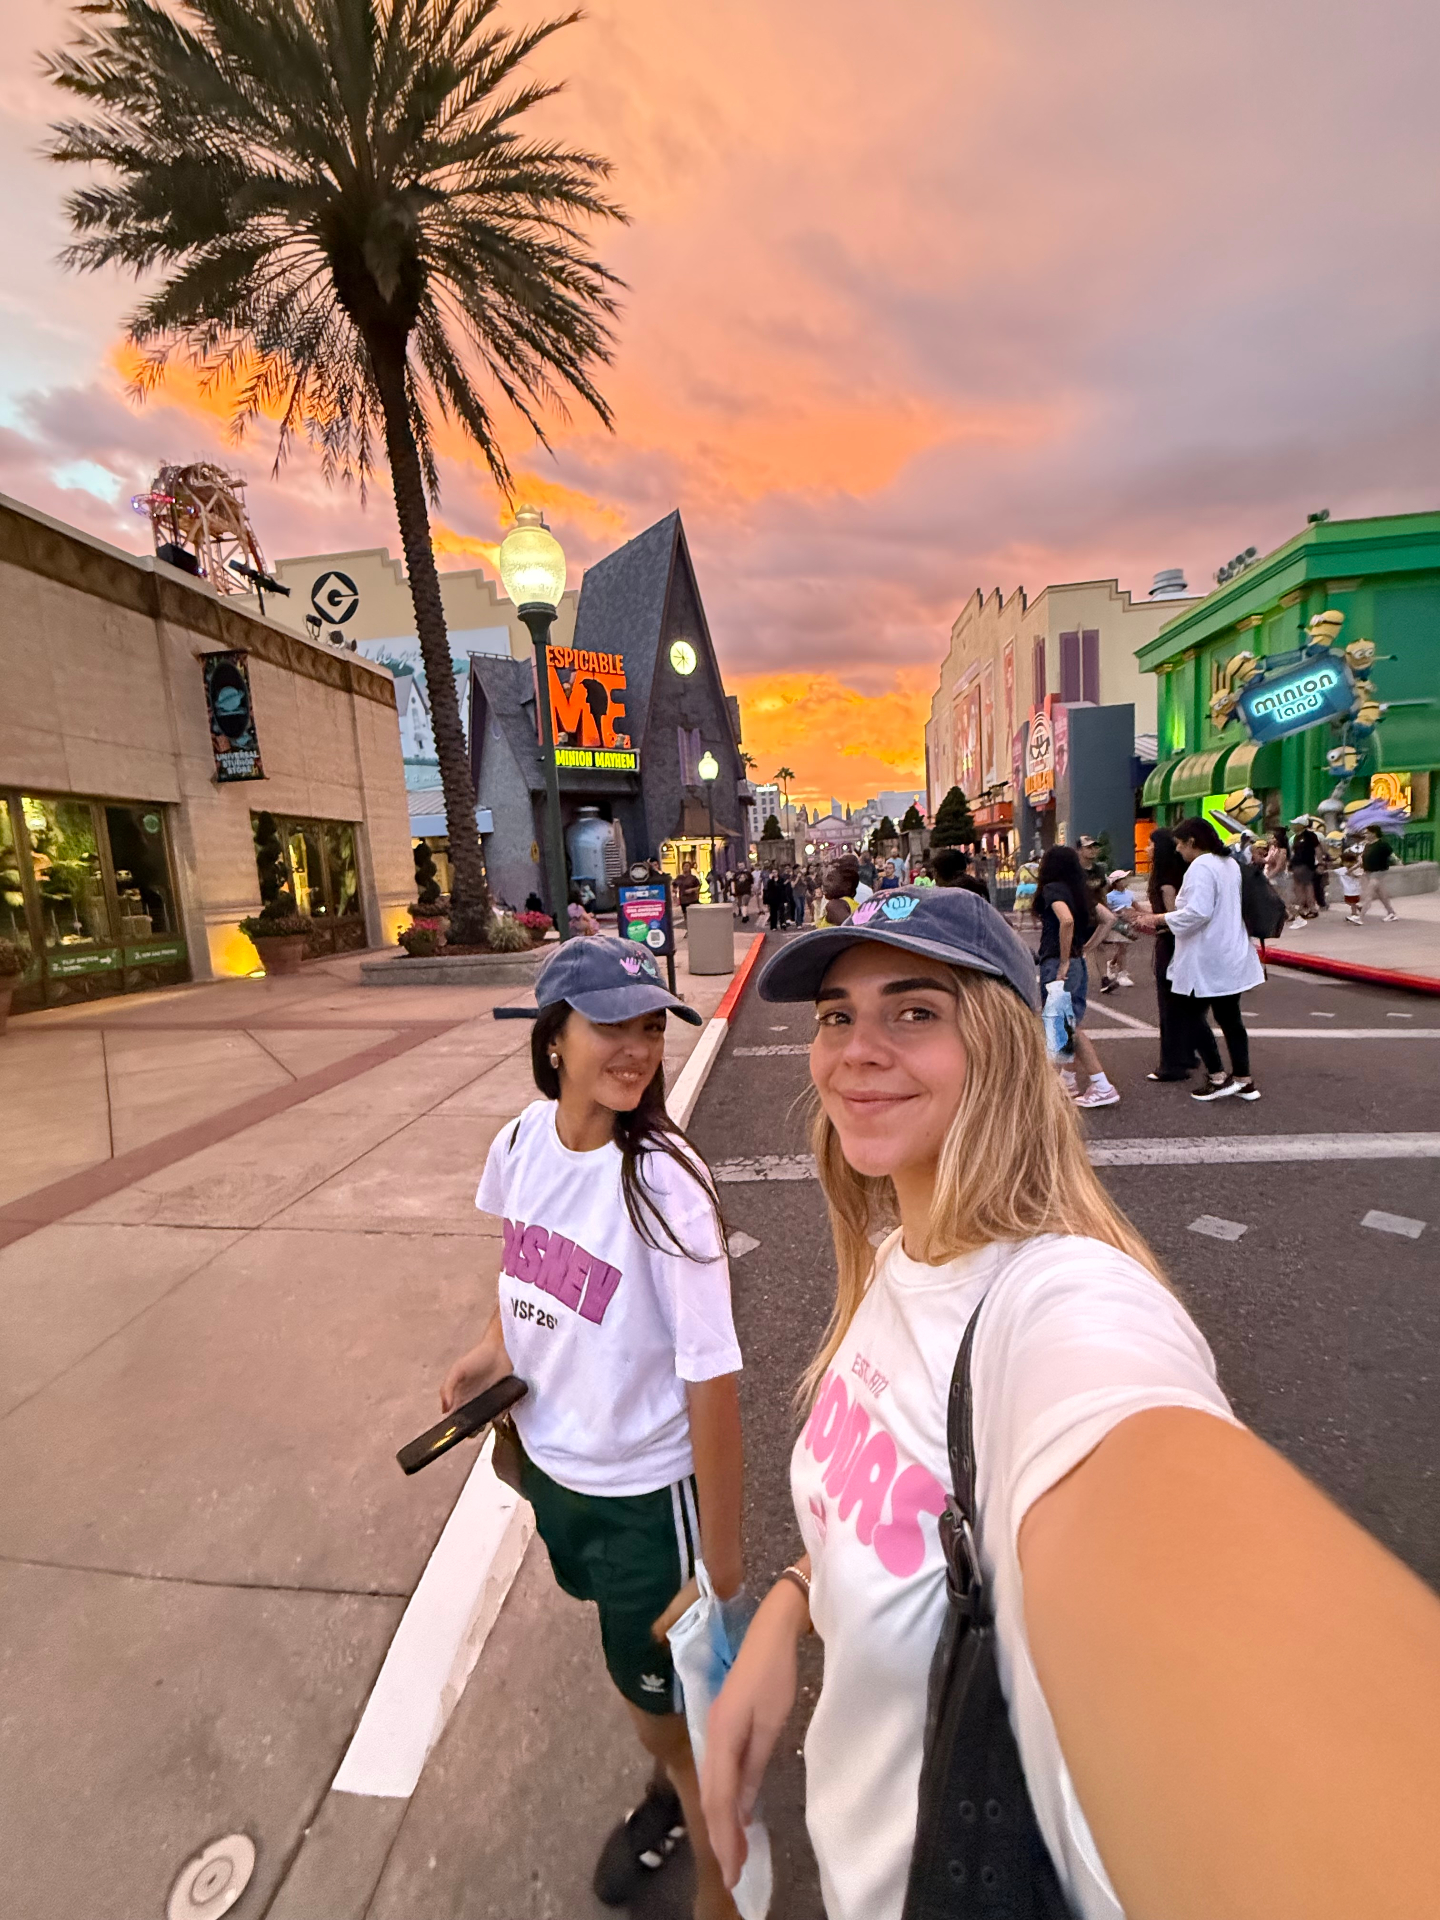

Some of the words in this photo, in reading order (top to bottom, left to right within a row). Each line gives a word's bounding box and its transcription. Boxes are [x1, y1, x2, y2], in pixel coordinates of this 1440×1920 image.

[546, 645, 625, 675] ESPICABLE
[1254, 674, 1334, 715] minion
[1276, 694, 1318, 720] land
[217, 751, 258, 760] UNIVERSAL
[555, 750, 592, 767] MINION
[595, 751, 636, 769] MAYHEM
